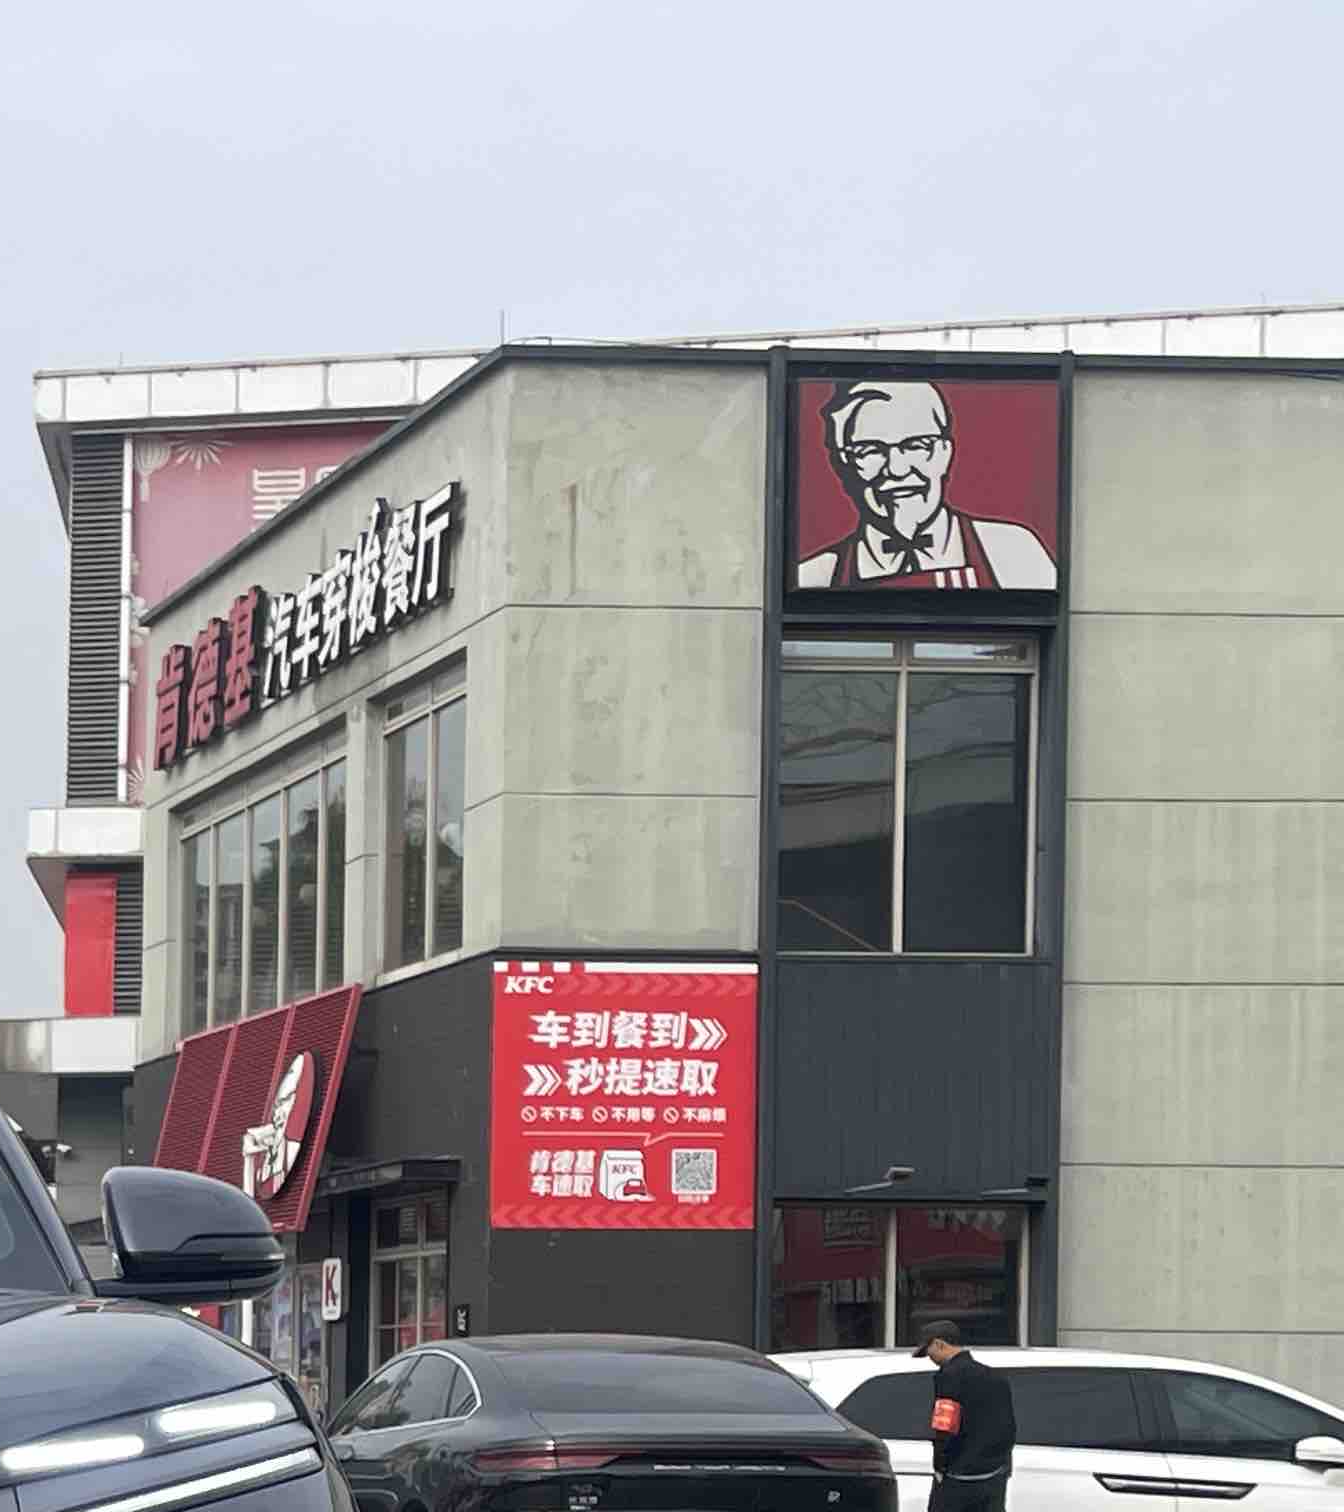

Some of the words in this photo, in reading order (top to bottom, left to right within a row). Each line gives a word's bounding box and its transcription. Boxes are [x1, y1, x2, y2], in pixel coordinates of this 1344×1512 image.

[504, 975, 554, 994] KFC
[529, 1010, 690, 1049] 车到餐到
[566, 1057, 720, 1097] 秒提速取
[540, 1106, 585, 1123] 不下车
